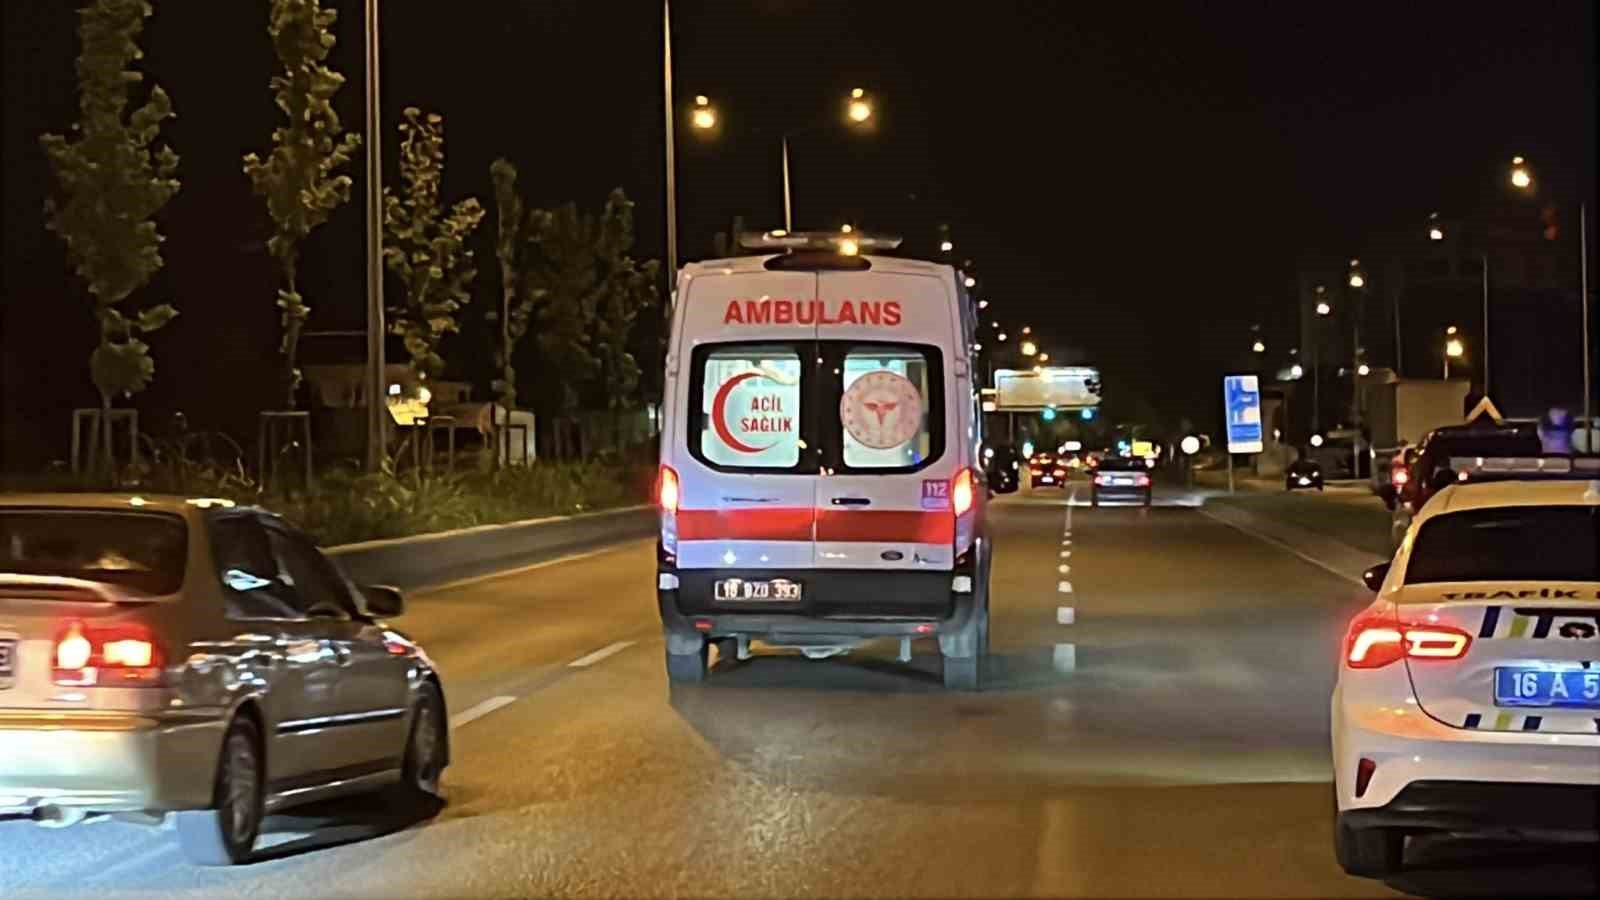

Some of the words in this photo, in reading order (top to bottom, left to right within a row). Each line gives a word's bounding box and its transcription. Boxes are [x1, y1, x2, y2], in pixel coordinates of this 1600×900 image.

[724, 301, 901, 325] AMBULANS
[751, 395, 783, 412] ACİL
[740, 415, 792, 432] SAĞLIK
[926, 482, 948, 497] 112
[1513, 673, 1537, 697] 16
[1550, 673, 1568, 698] A
